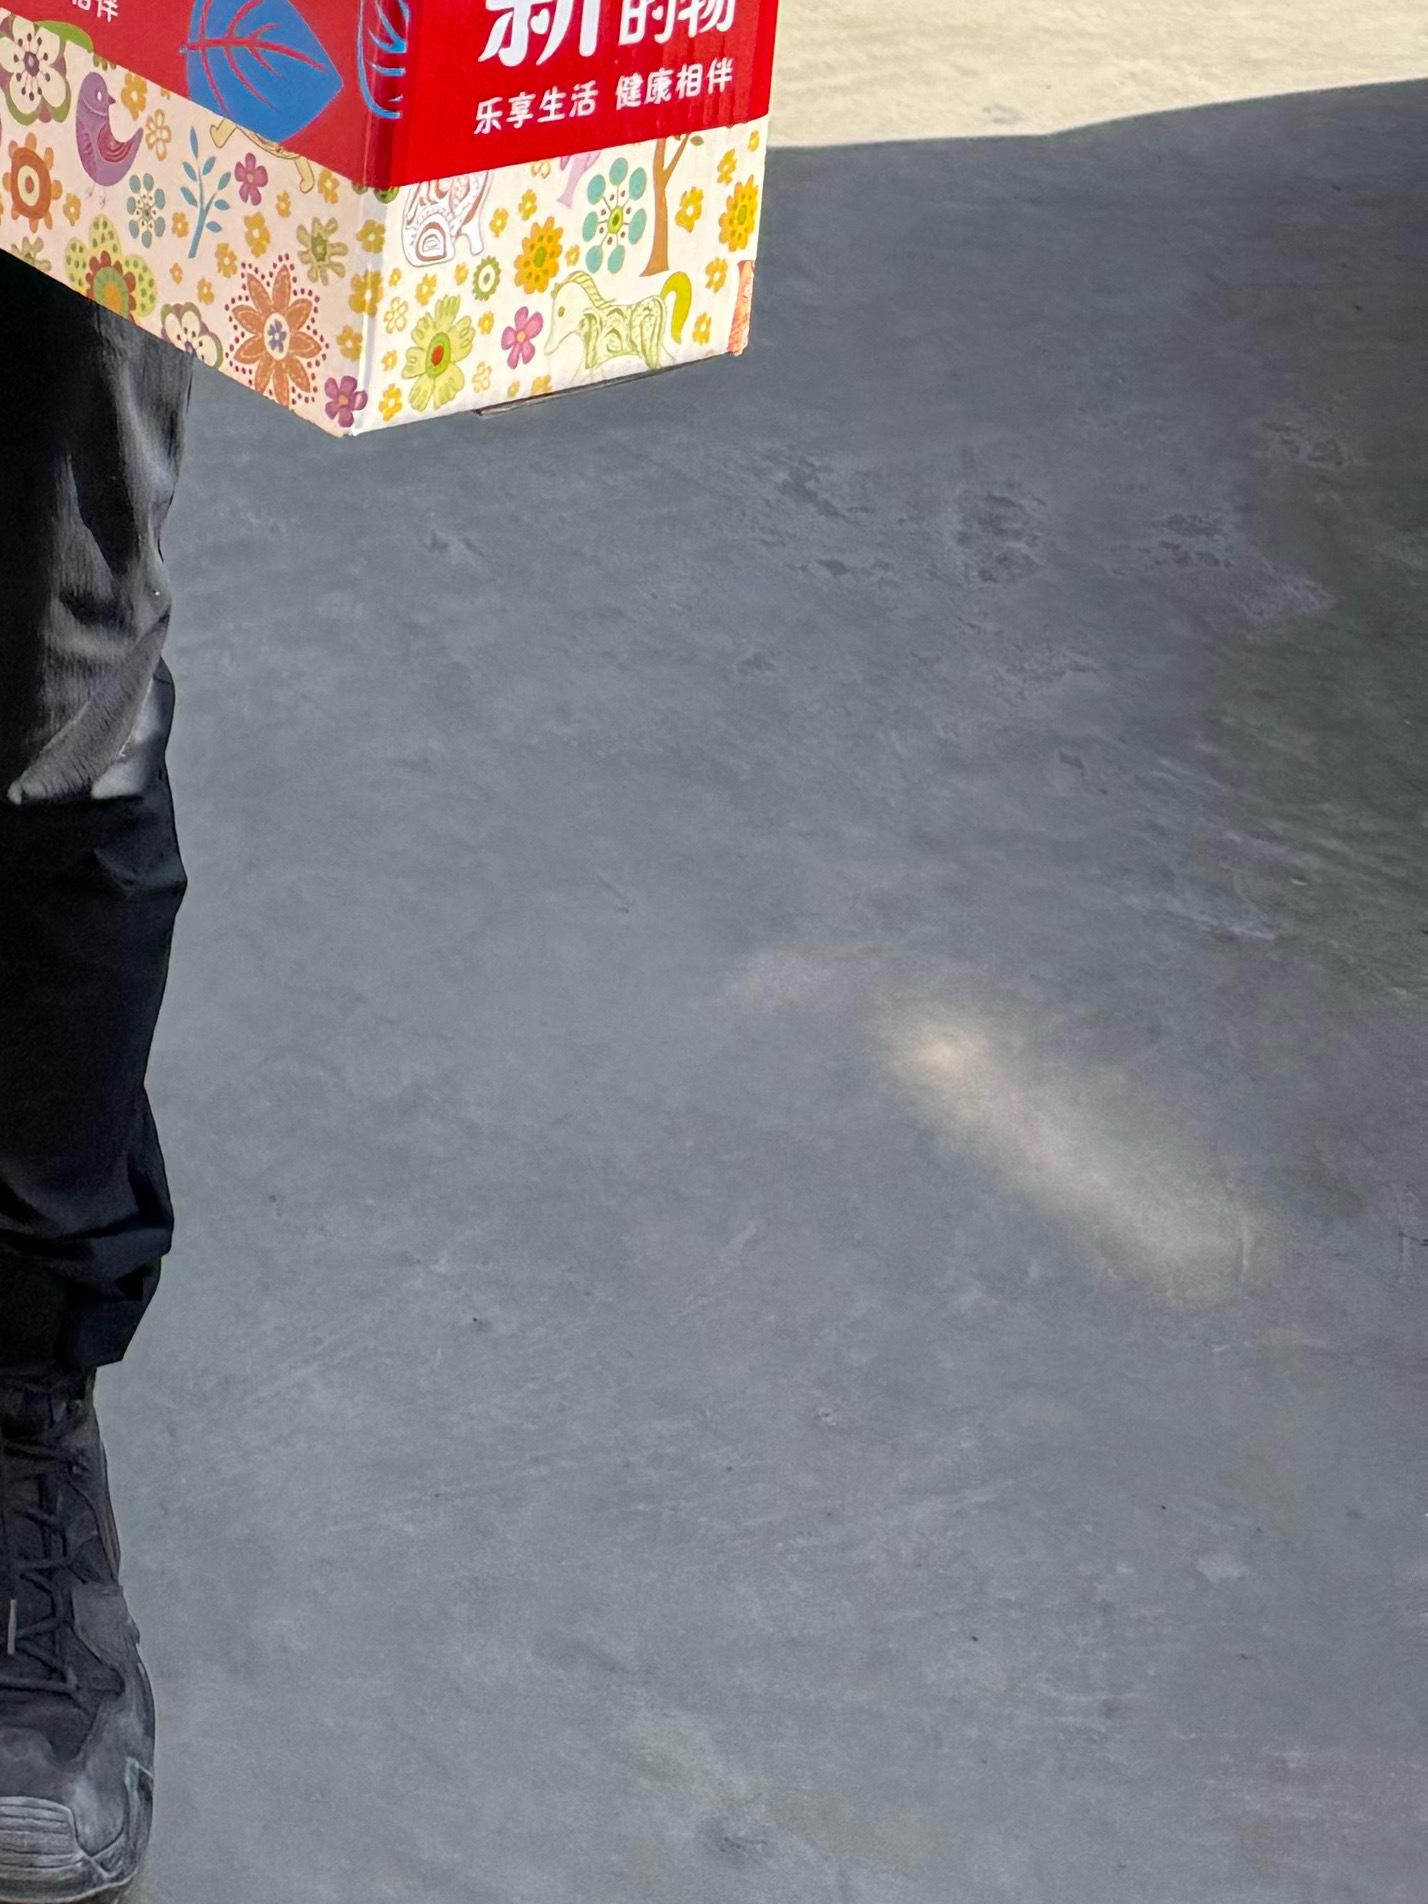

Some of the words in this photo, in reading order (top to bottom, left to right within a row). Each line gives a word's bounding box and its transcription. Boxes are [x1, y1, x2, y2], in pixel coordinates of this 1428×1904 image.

[473, 79, 599, 136] 乐享生活
[614, 57, 735, 113] 健康相伴
